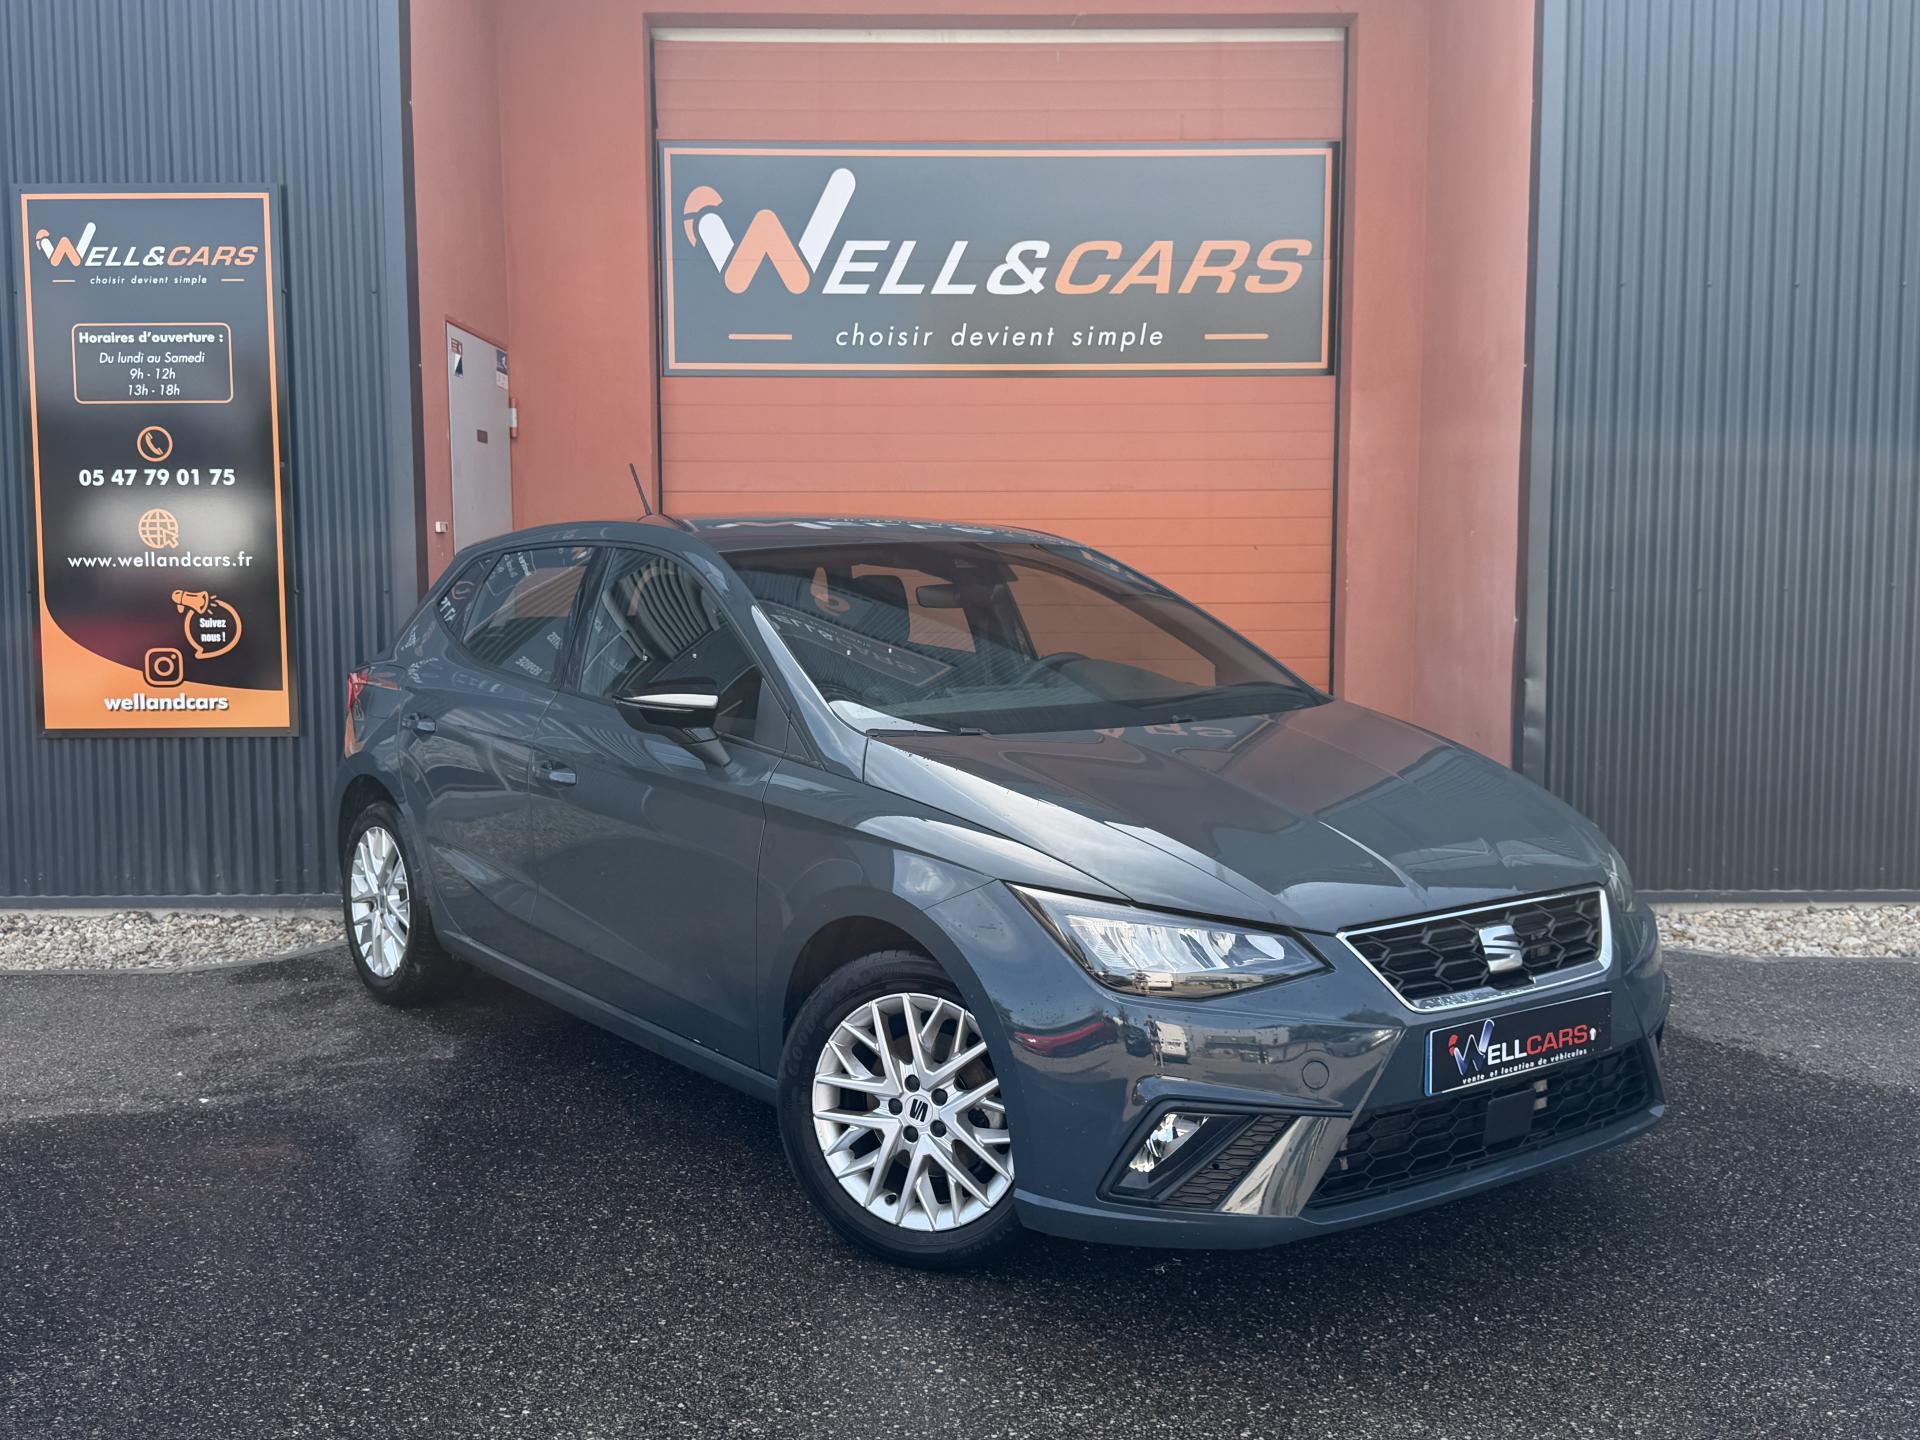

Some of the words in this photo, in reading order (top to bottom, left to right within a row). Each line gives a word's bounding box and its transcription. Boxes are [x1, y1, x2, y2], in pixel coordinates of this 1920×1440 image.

[698, 167, 1313, 296] WELL&CARS
[40, 221, 259, 267] WELL&CARS
[90, 275, 125, 285] choisir
[131, 275, 168, 285] devient
[174, 275, 208, 286] simple
[79, 332, 135, 344] Horaires
[139, 331, 216, 344] d'ouverture
[835, 322, 933, 348] choisir
[951, 322, 1056, 348] devient
[1071, 322, 1165, 352] simple
[99, 352, 115, 364] Du
[117, 352, 145, 364] lundi
[148, 355, 161, 364] au
[164, 352, 206, 364] Samedi
[129, 368, 144, 380] 9h
[155, 368, 176, 380] 12h
[128, 385, 149, 396] 13h
[160, 385, 181, 396] 18h
[78, 469, 105, 487] 05
[111, 469, 137, 486] 47
[144, 469, 170, 486] 79
[176, 469, 200, 486] 01
[209, 469, 236, 486] 75
[67, 551, 253, 568] www.wellandcars.fr
[199, 617, 227, 629] Suivez
[201, 632, 221, 643] nous
[104, 693, 230, 711] wellandcars
[1450, 1018, 1589, 1077] WELLCARS
[1462, 1074, 1485, 1085] vente
[1489, 1070, 1498, 1078] et
[1501, 1060, 1535, 1075] location
[1537, 1057, 1548, 1066] de
